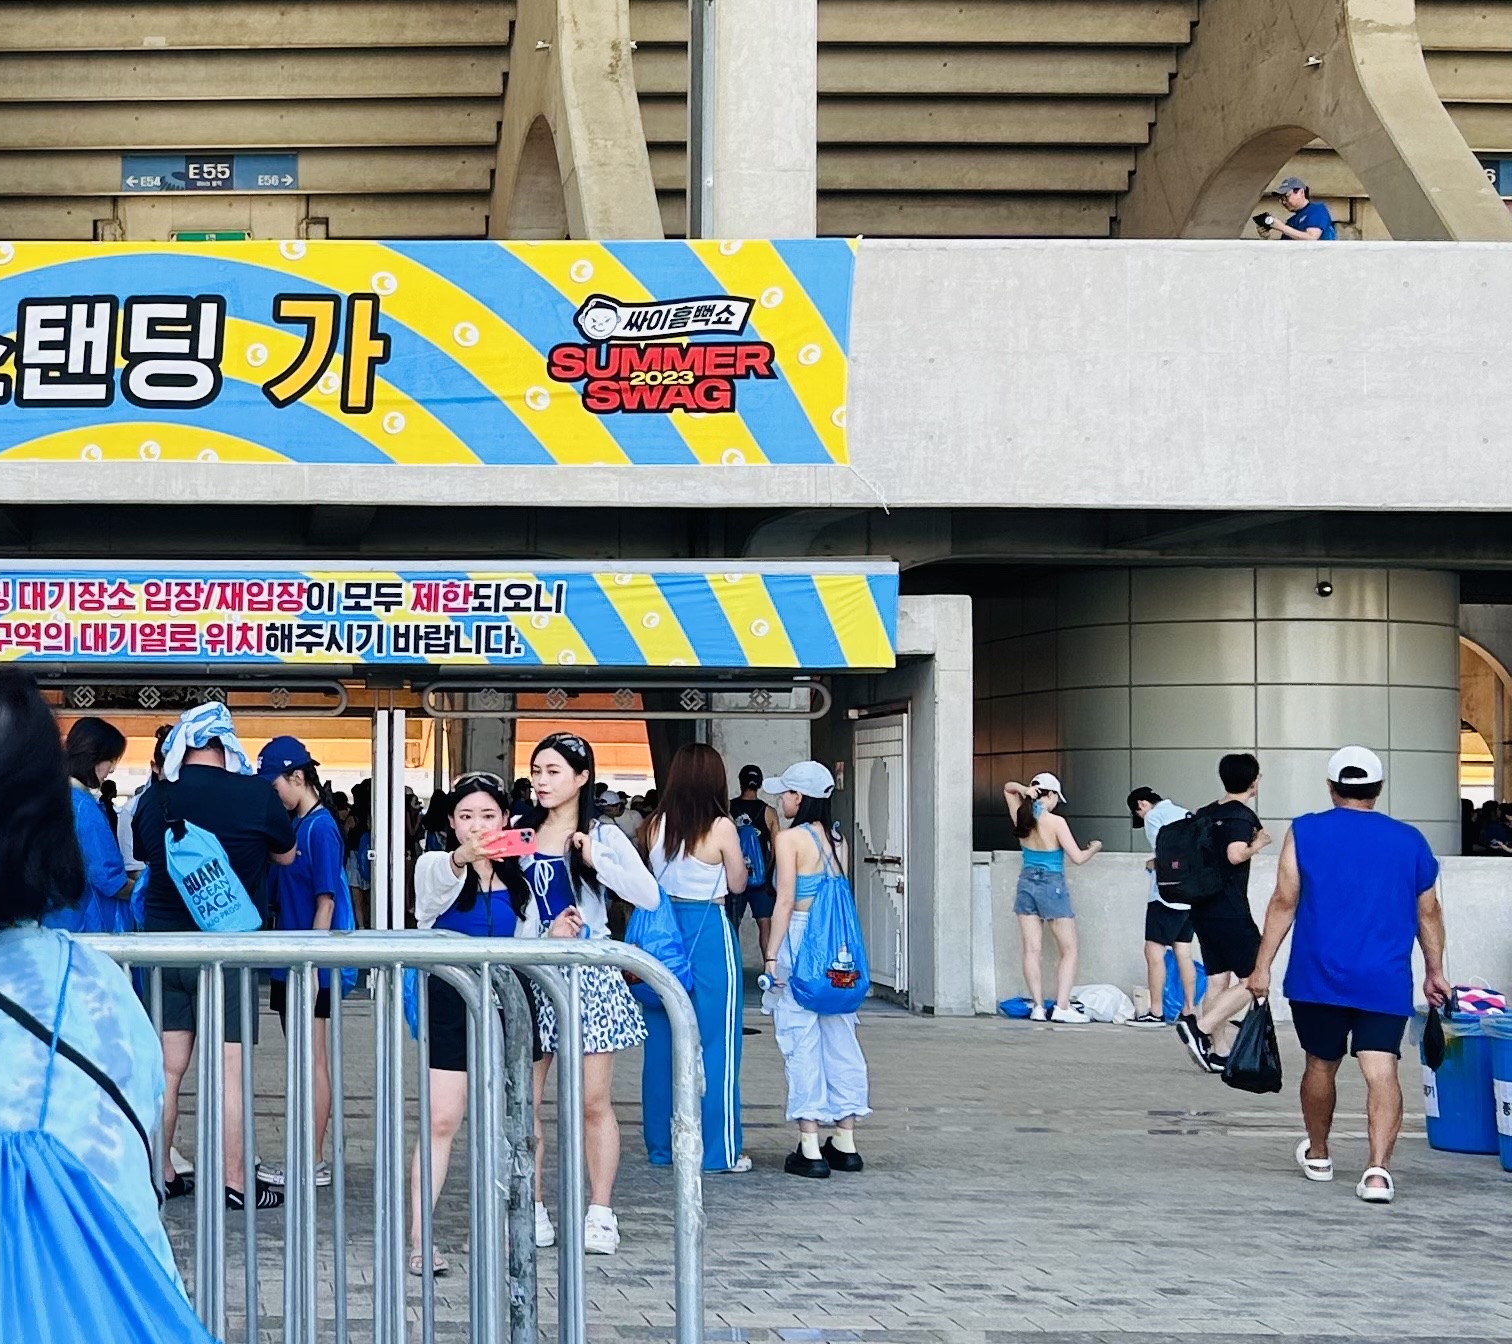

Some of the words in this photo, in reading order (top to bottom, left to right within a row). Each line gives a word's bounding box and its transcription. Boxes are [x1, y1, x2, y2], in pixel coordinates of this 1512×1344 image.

[621, 303, 737, 333] 싸이흠뻑쇼
[264, 294, 388, 412] 가
[550, 345, 771, 379] SUMMER
[585, 378, 733, 411] SWAG
[629, 370, 695, 386] 2023
[18, 580, 136, 612] 대기장소
[143, 581, 334, 612] 입장/재입장이
[342, 582, 404, 613] 모두
[410, 581, 565, 613] 제한되오니
[80, 622, 198, 653] 대기열로
[204, 622, 385, 654] 위치해주시기
[392, 624, 522, 655] 바랍니다.
[192, 879, 229, 905] OCEAN
[197, 886, 238, 920] PACK
